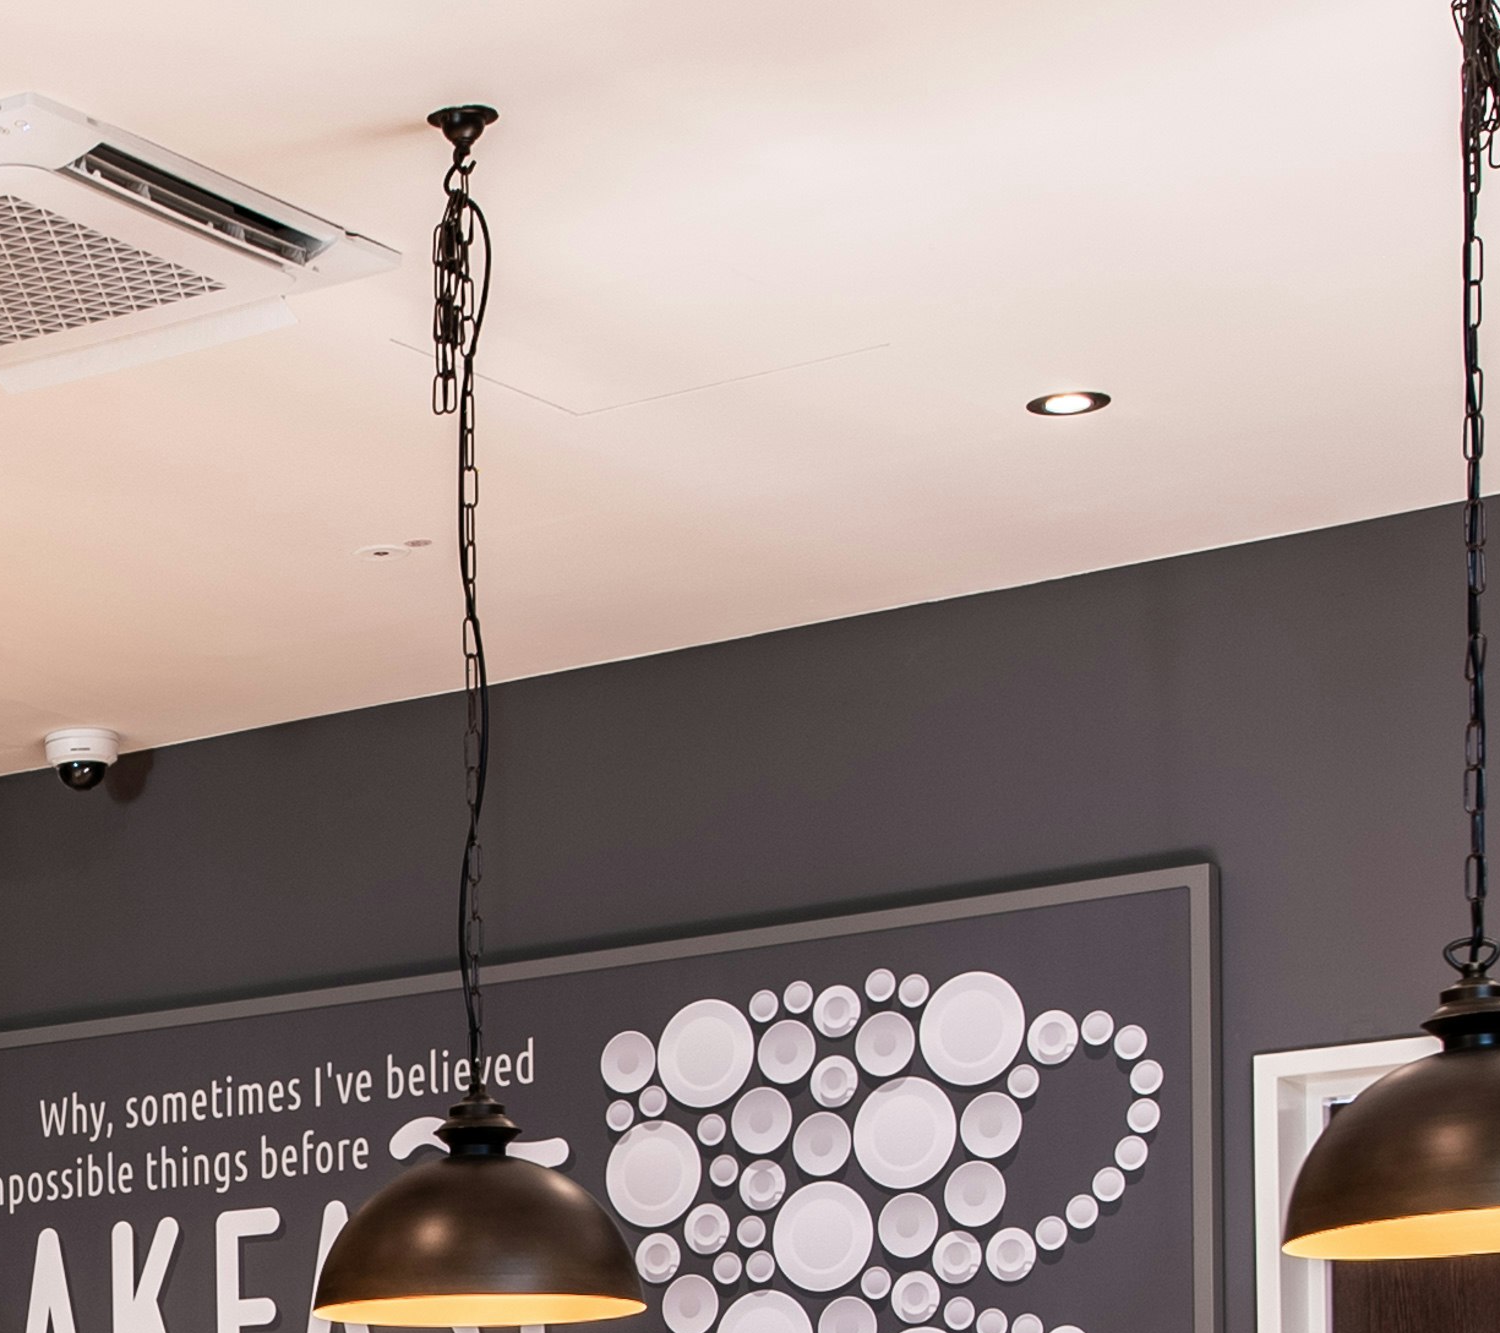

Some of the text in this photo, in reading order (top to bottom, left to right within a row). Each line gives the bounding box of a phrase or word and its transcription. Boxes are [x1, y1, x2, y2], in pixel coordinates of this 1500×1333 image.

[38, 1036, 536, 1142] Why, sometimes I've believed
[146, 1147, 249, 1193] things
[260, 1130, 371, 1182] before
